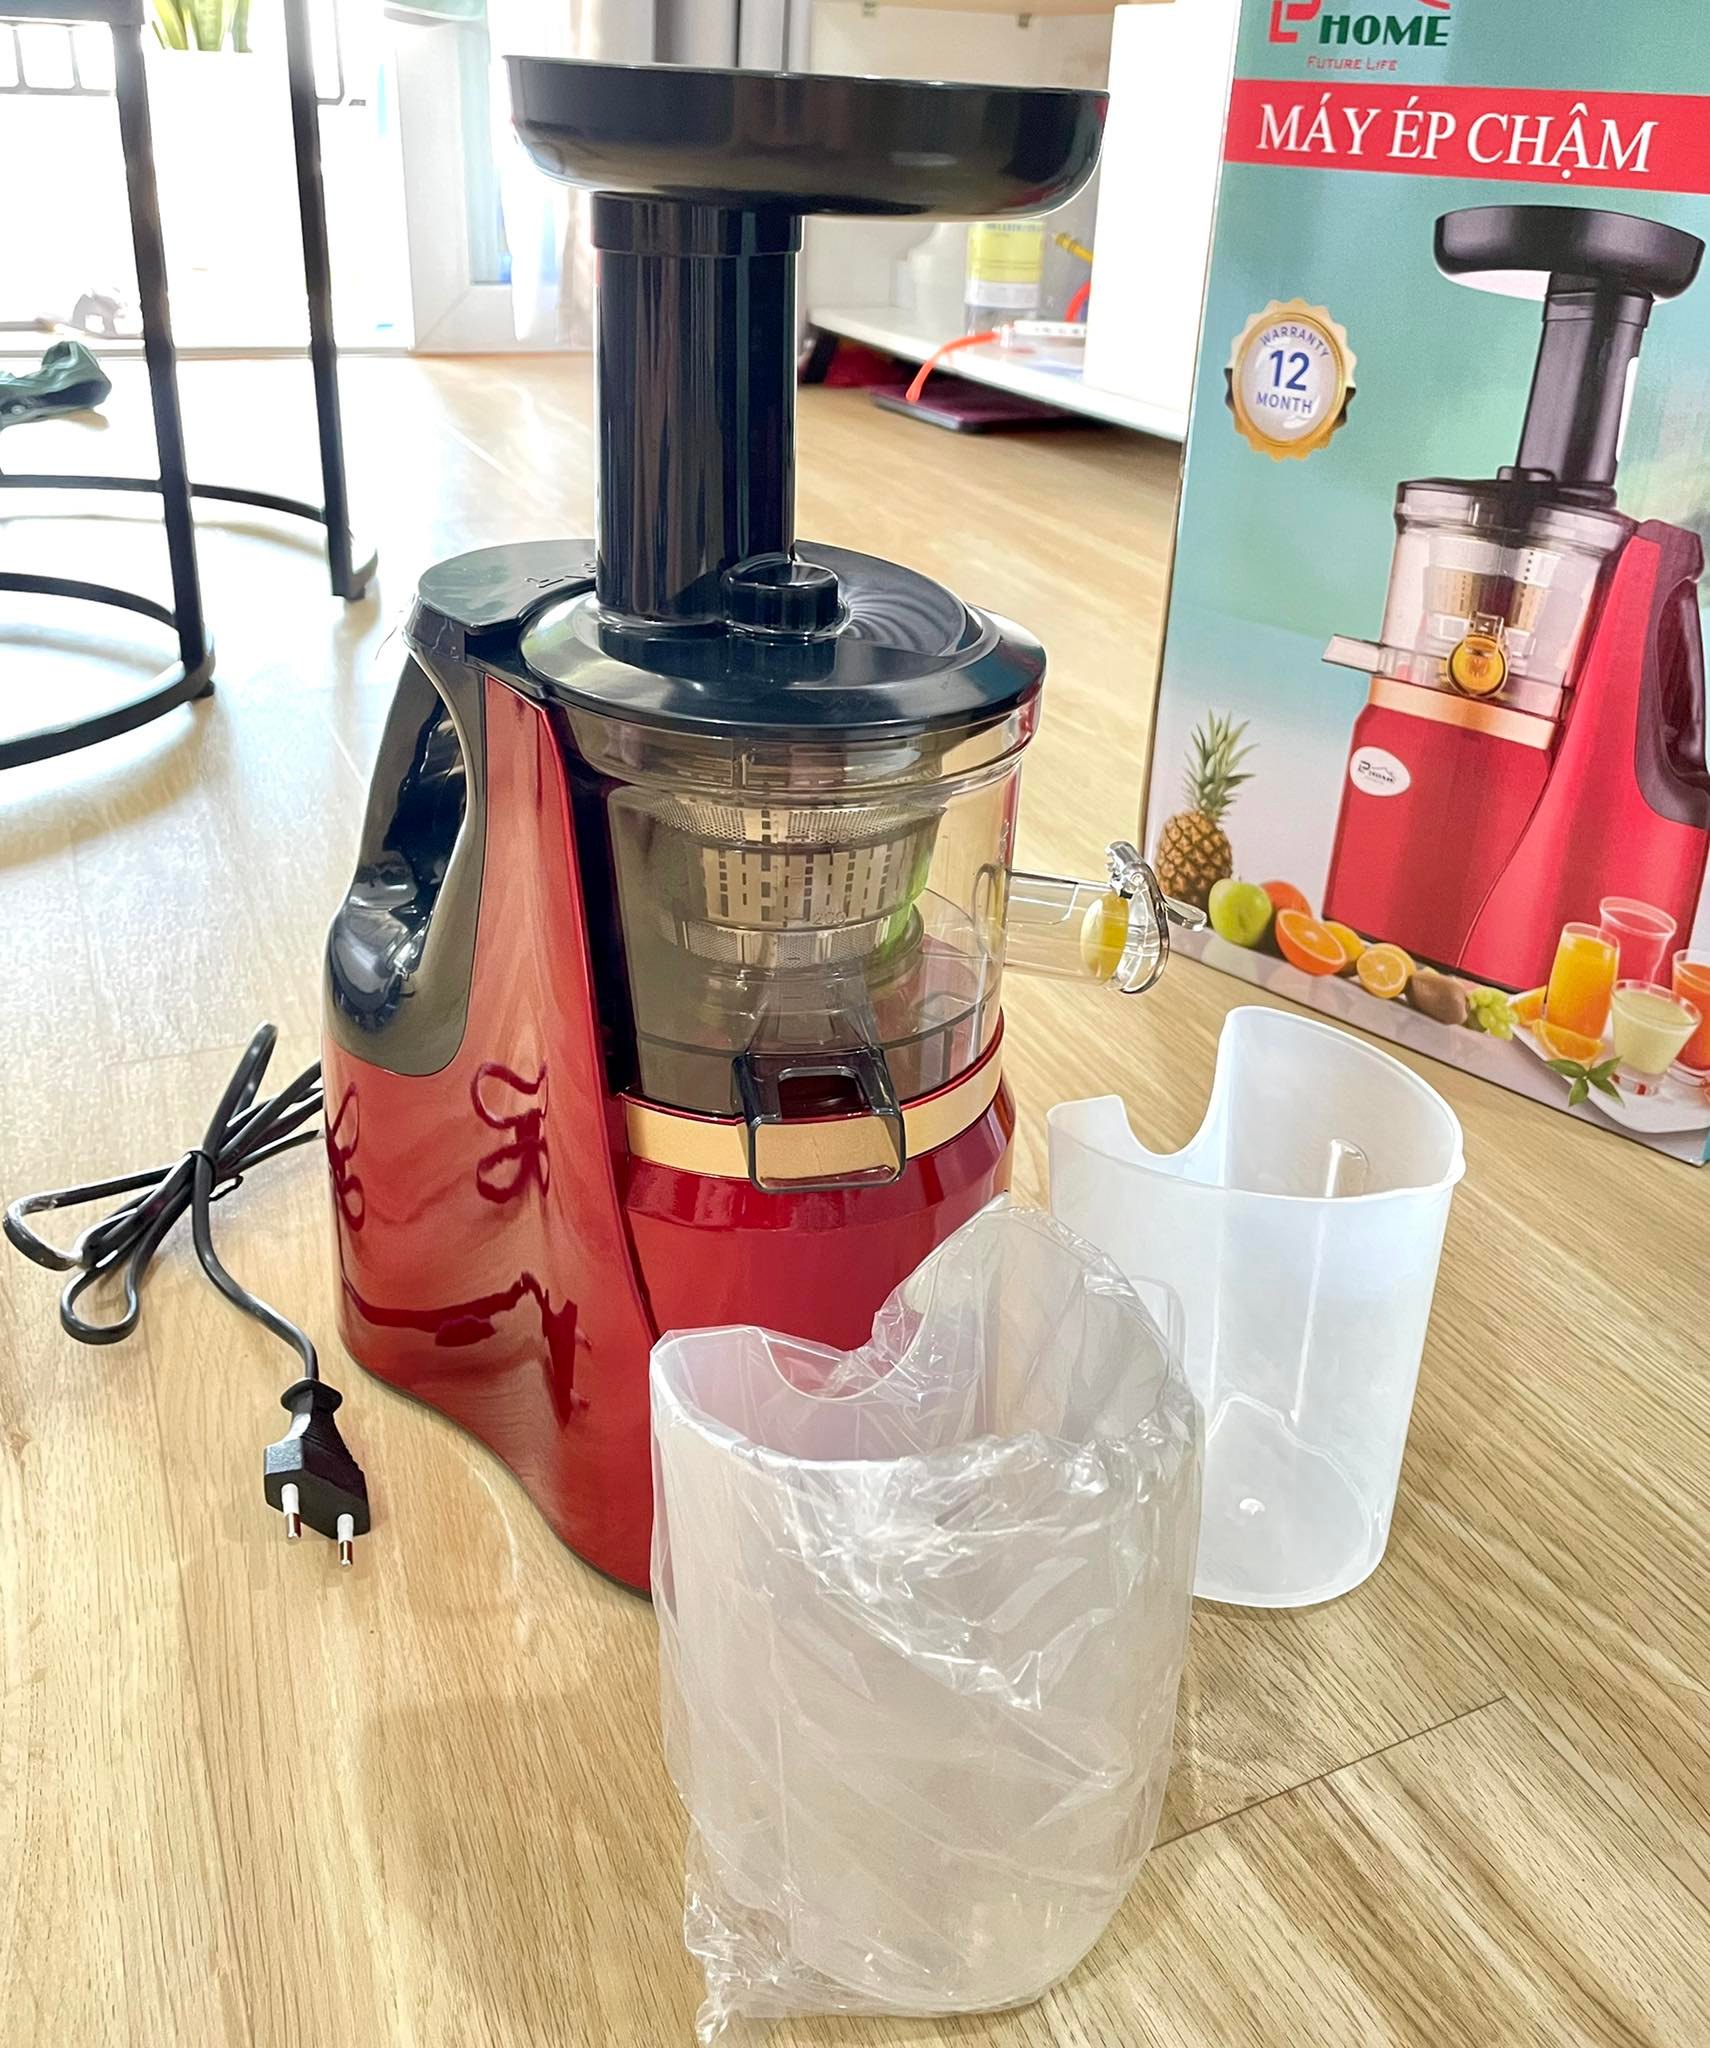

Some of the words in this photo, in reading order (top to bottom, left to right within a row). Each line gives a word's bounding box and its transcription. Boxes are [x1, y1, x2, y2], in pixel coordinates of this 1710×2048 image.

[1319, 15, 1451, 46] HOME
[1307, 55, 1362, 70] FUTURE
[1366, 57, 1398, 71] LIFE
[1256, 92, 1379, 156] MÁY
[1386, 96, 1457, 160] ÉP
[1466, 102, 1659, 180] CHẬM
[1260, 326, 1330, 358] WARRANTY
[1269, 350, 1310, 391] 12
[1256, 391, 1313, 414] MONTH
